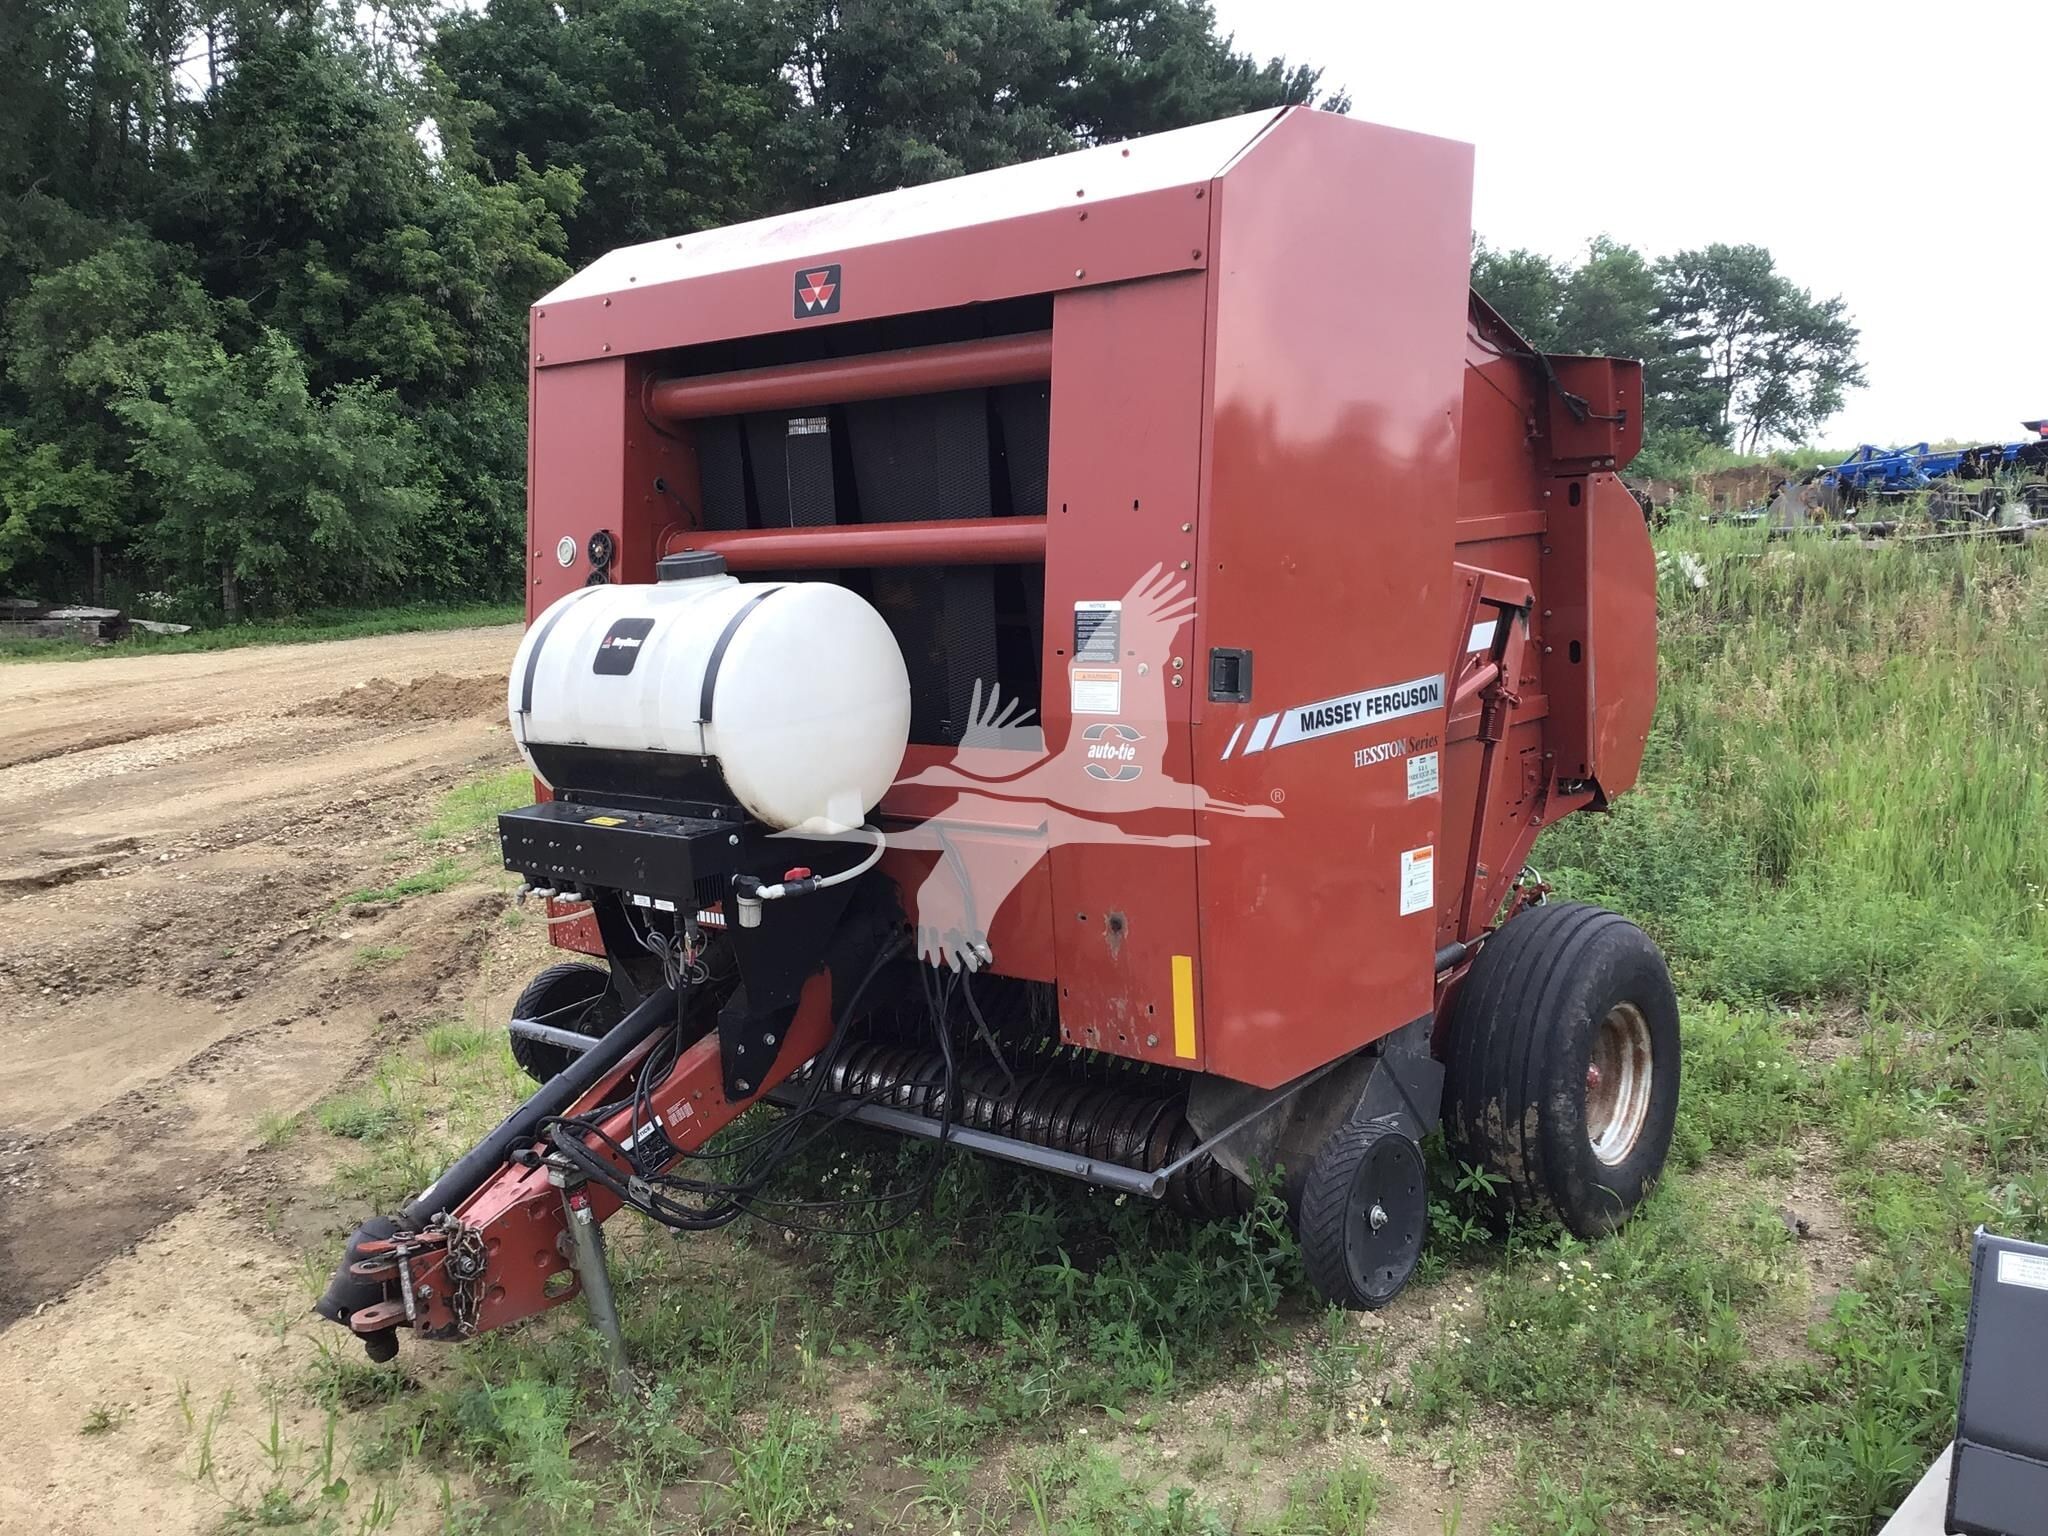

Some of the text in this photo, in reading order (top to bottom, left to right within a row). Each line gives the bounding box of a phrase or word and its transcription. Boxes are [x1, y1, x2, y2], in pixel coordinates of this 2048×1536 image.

[1300, 683, 1439, 732] MASSEY FERGUSON
[1087, 741, 1136, 761] auto-tie
[1354, 732, 1439, 768] HESSTON Series
